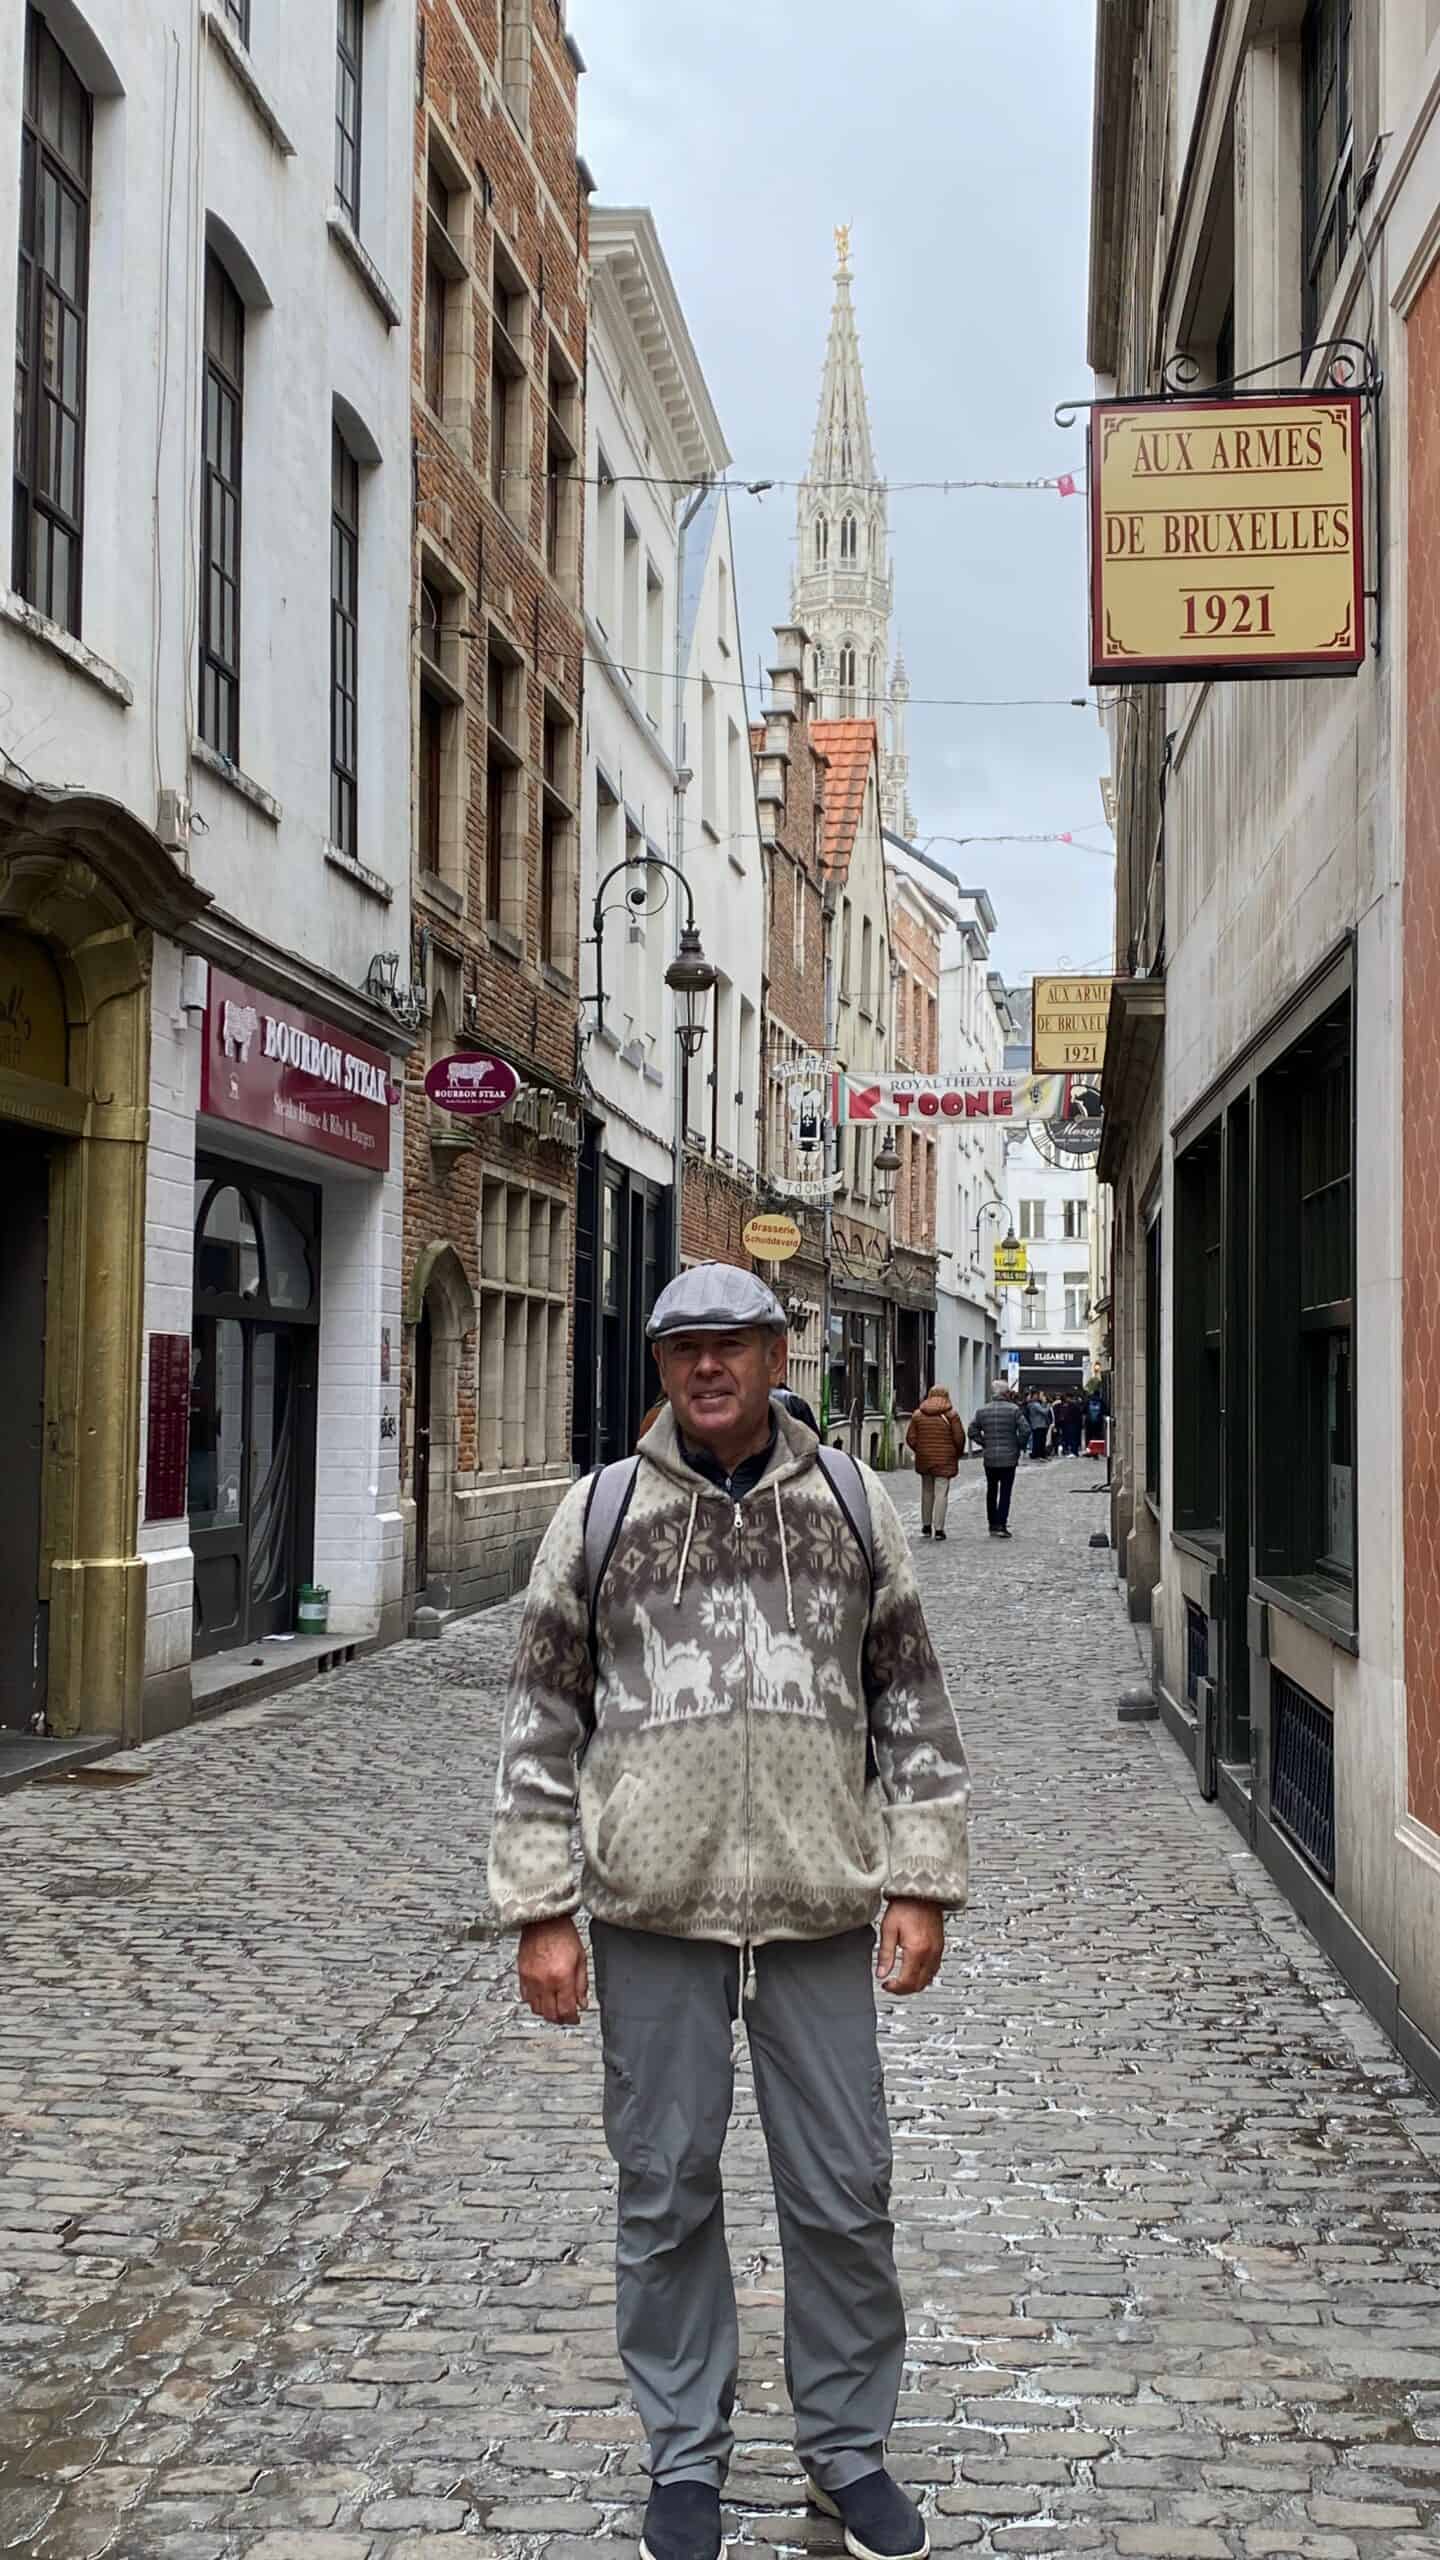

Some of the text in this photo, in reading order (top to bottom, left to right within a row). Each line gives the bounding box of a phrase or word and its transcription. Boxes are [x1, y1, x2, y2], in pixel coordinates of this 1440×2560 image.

[1133, 427, 1323, 474] AUX ARMES
[1105, 508, 1350, 555] DE BRUXELLES
[1183, 592, 1273, 635] 1921
[1047, 985, 1111, 1001] AUX ARME
[1037, 1016, 1049, 1031] DE
[263, 1015, 388, 1106] BOURBON STEAK
[1064, 1046, 1097, 1062] 1921
[890, 1075, 1017, 1092] ROYAL THEATRE
[434, 1089, 507, 1098] BOURBON STEAK
[892, 1090, 1014, 1117] TOONE
[751, 1221, 796, 1235] Brasserie
